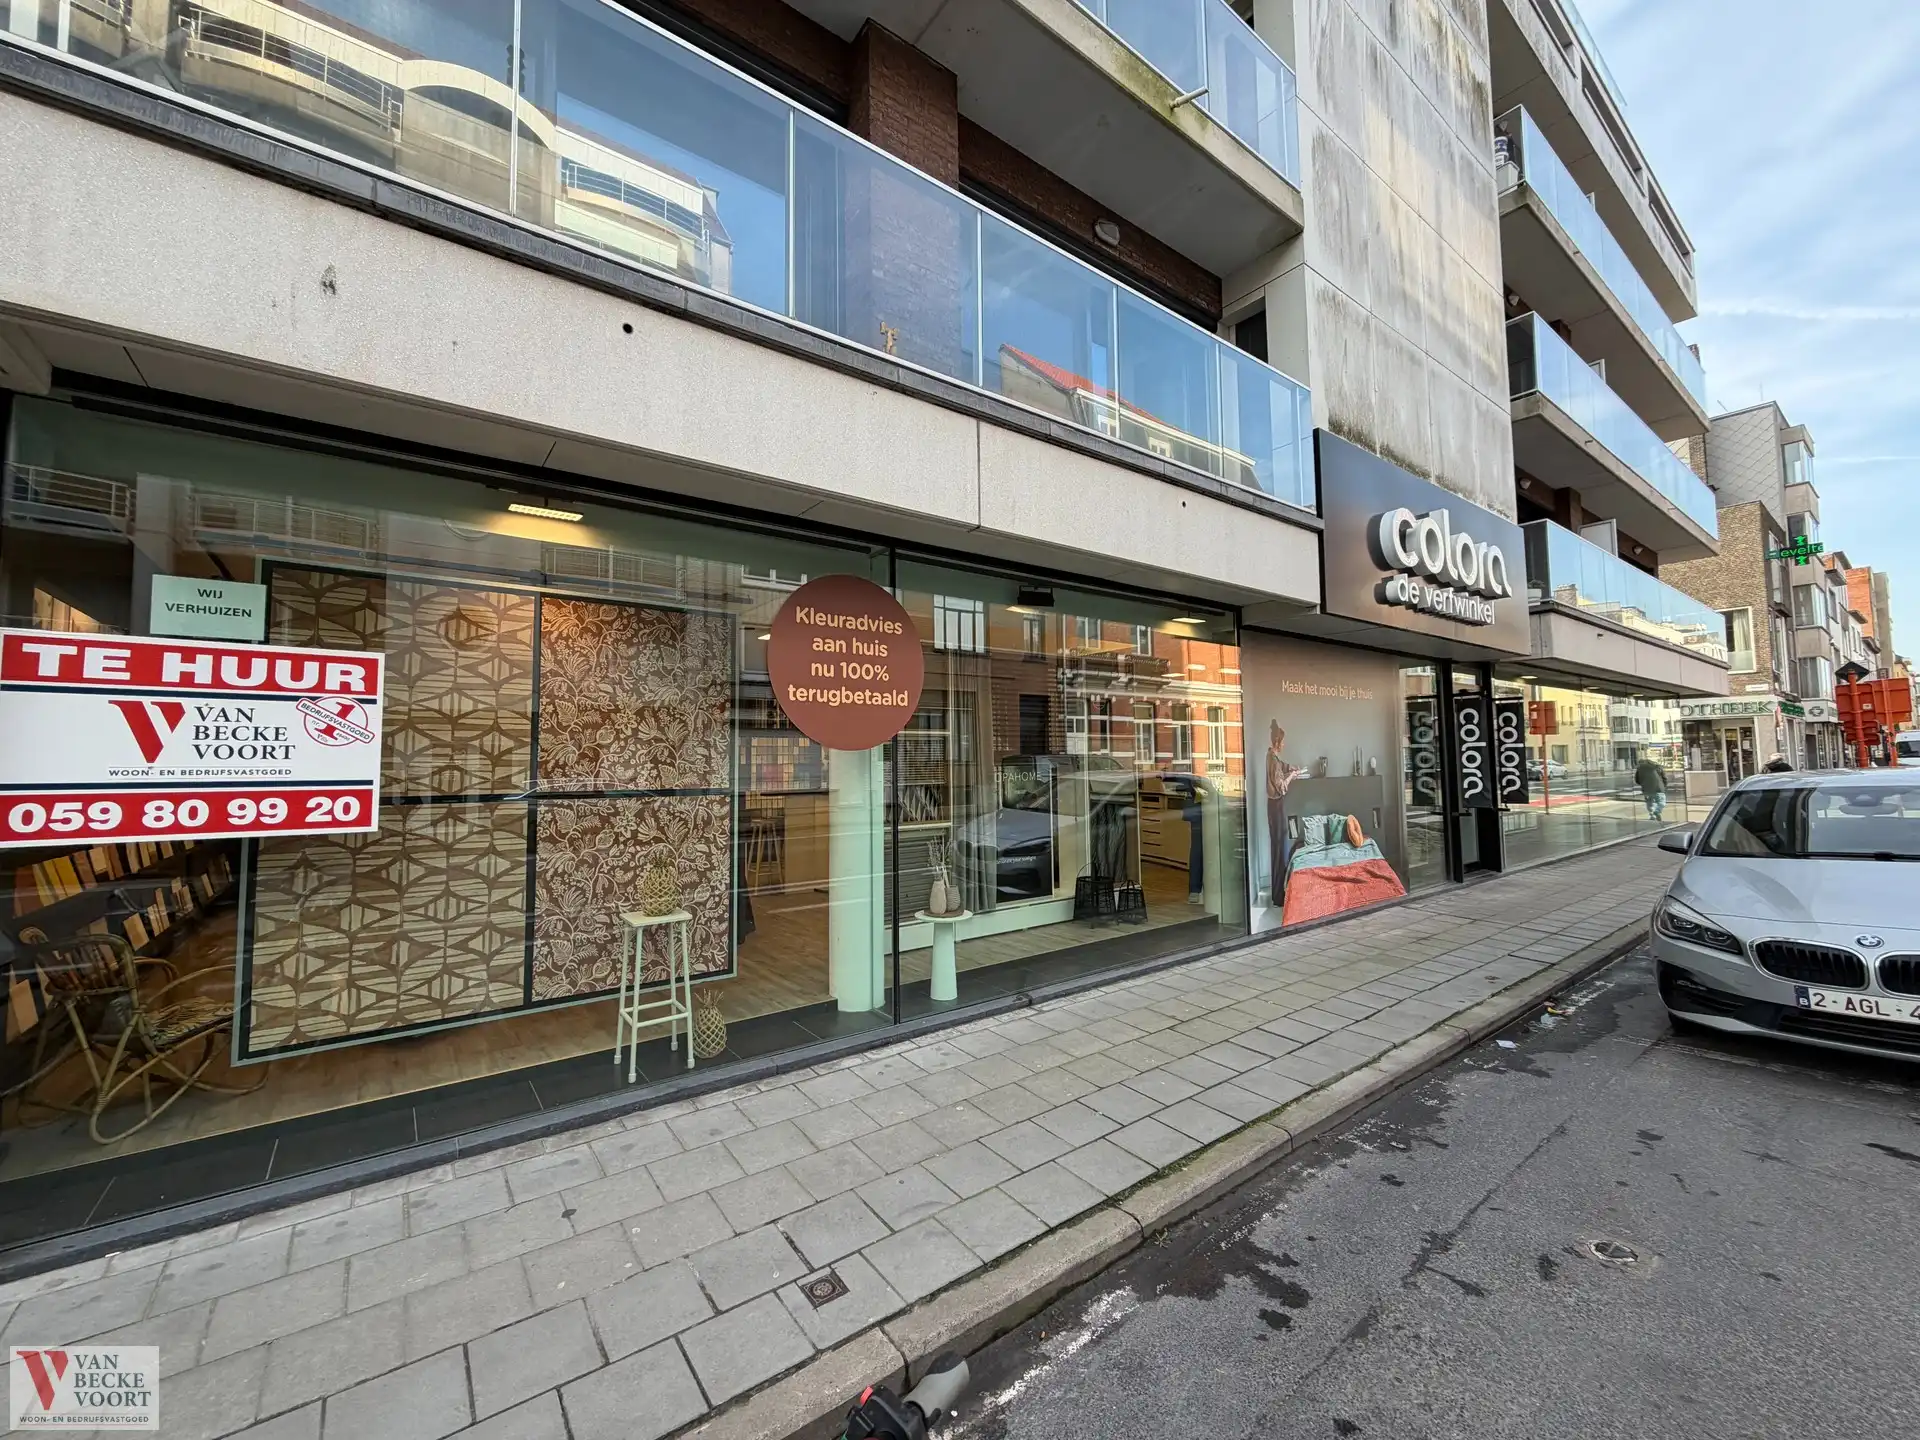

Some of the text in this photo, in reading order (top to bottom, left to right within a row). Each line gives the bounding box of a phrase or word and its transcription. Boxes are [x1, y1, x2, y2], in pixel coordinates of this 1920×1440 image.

[1380, 507, 1512, 598] colora
[197, 588, 223, 599] WIJ
[165, 602, 252, 618] VERHUIZEN
[1422, 586, 1495, 625] verfwinkel
[795, 606, 904, 635] Kleuradvies
[812, 637, 889, 657] aan huis
[22, 643, 367, 692] TE HUUR
[811, 661, 890, 682] nu 100%
[788, 684, 909, 707] terugbetaald
[1282, 680, 1304, 694] Maak
[1305, 682, 1318, 695] het
[1319, 685, 1338, 697] mooi
[1356, 688, 1373, 700] thuis
[194, 705, 256, 724] VAN
[300, 702, 371, 740] BEDRIJFSVASTGOED
[192, 724, 289, 742] BECKE
[192, 744, 296, 761] VOORT
[1460, 708, 1487, 799] colora
[1498, 712, 1525, 796] colora
[108, 769, 154, 777] WOON-
[180, 768, 292, 777] BEDRIJFSVASTGOED
[8, 795, 361, 833] 059 80 99 20
